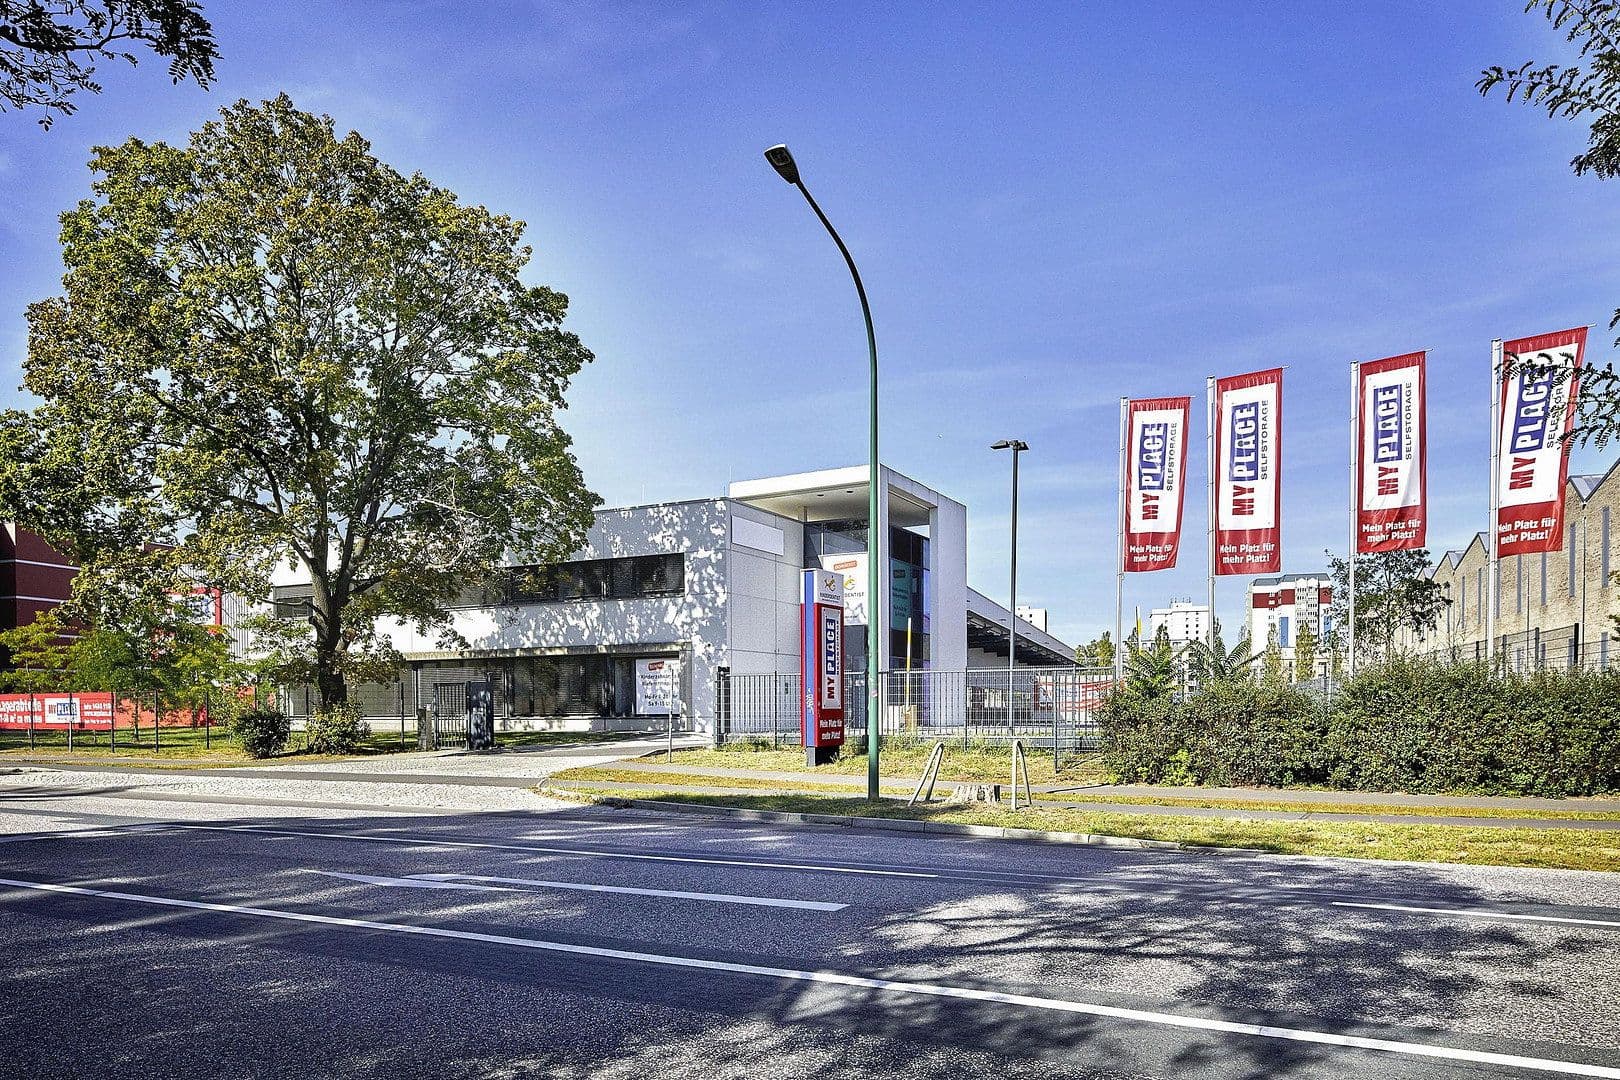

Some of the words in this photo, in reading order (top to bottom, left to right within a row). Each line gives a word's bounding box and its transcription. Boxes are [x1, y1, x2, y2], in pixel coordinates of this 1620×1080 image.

[1515, 369, 1550, 450] PLACE
[1546, 364, 1565, 448] SELFSTORE
[1376, 385, 1399, 459] PLACE
[1232, 402, 1257, 479] PLACE
[1260, 400, 1268, 480] SELFSTORAGE
[1140, 423, 1165, 488] PLACE
[1166, 422, 1178, 491] SELFSTORAGE
[1378, 466, 1398, 496] MY
[1509, 456, 1536, 490] MY
[1142, 493, 1160, 520] MY
[1232, 485, 1254, 516] MY
[1362, 523, 1382, 532] Mein
[1385, 521, 1406, 530] Platz
[1408, 519, 1421, 528] für
[1367, 533, 1390, 542] mehr
[1392, 530, 1416, 540] Platz!
[1514, 520, 1538, 530] Platz
[1541, 518, 1556, 528] für
[1520, 530, 1548, 542] Platz!
[1134, 554, 1148, 562] mehr
[1146, 544, 1162, 552] Platz
[1222, 555, 1244, 564] mehr
[1246, 554, 1270, 562] Platz!
[1240, 544, 1260, 552] Platz
[1262, 542, 1274, 552] für
[826, 618, 836, 672] PLACE
[827, 676, 834, 700] MY
